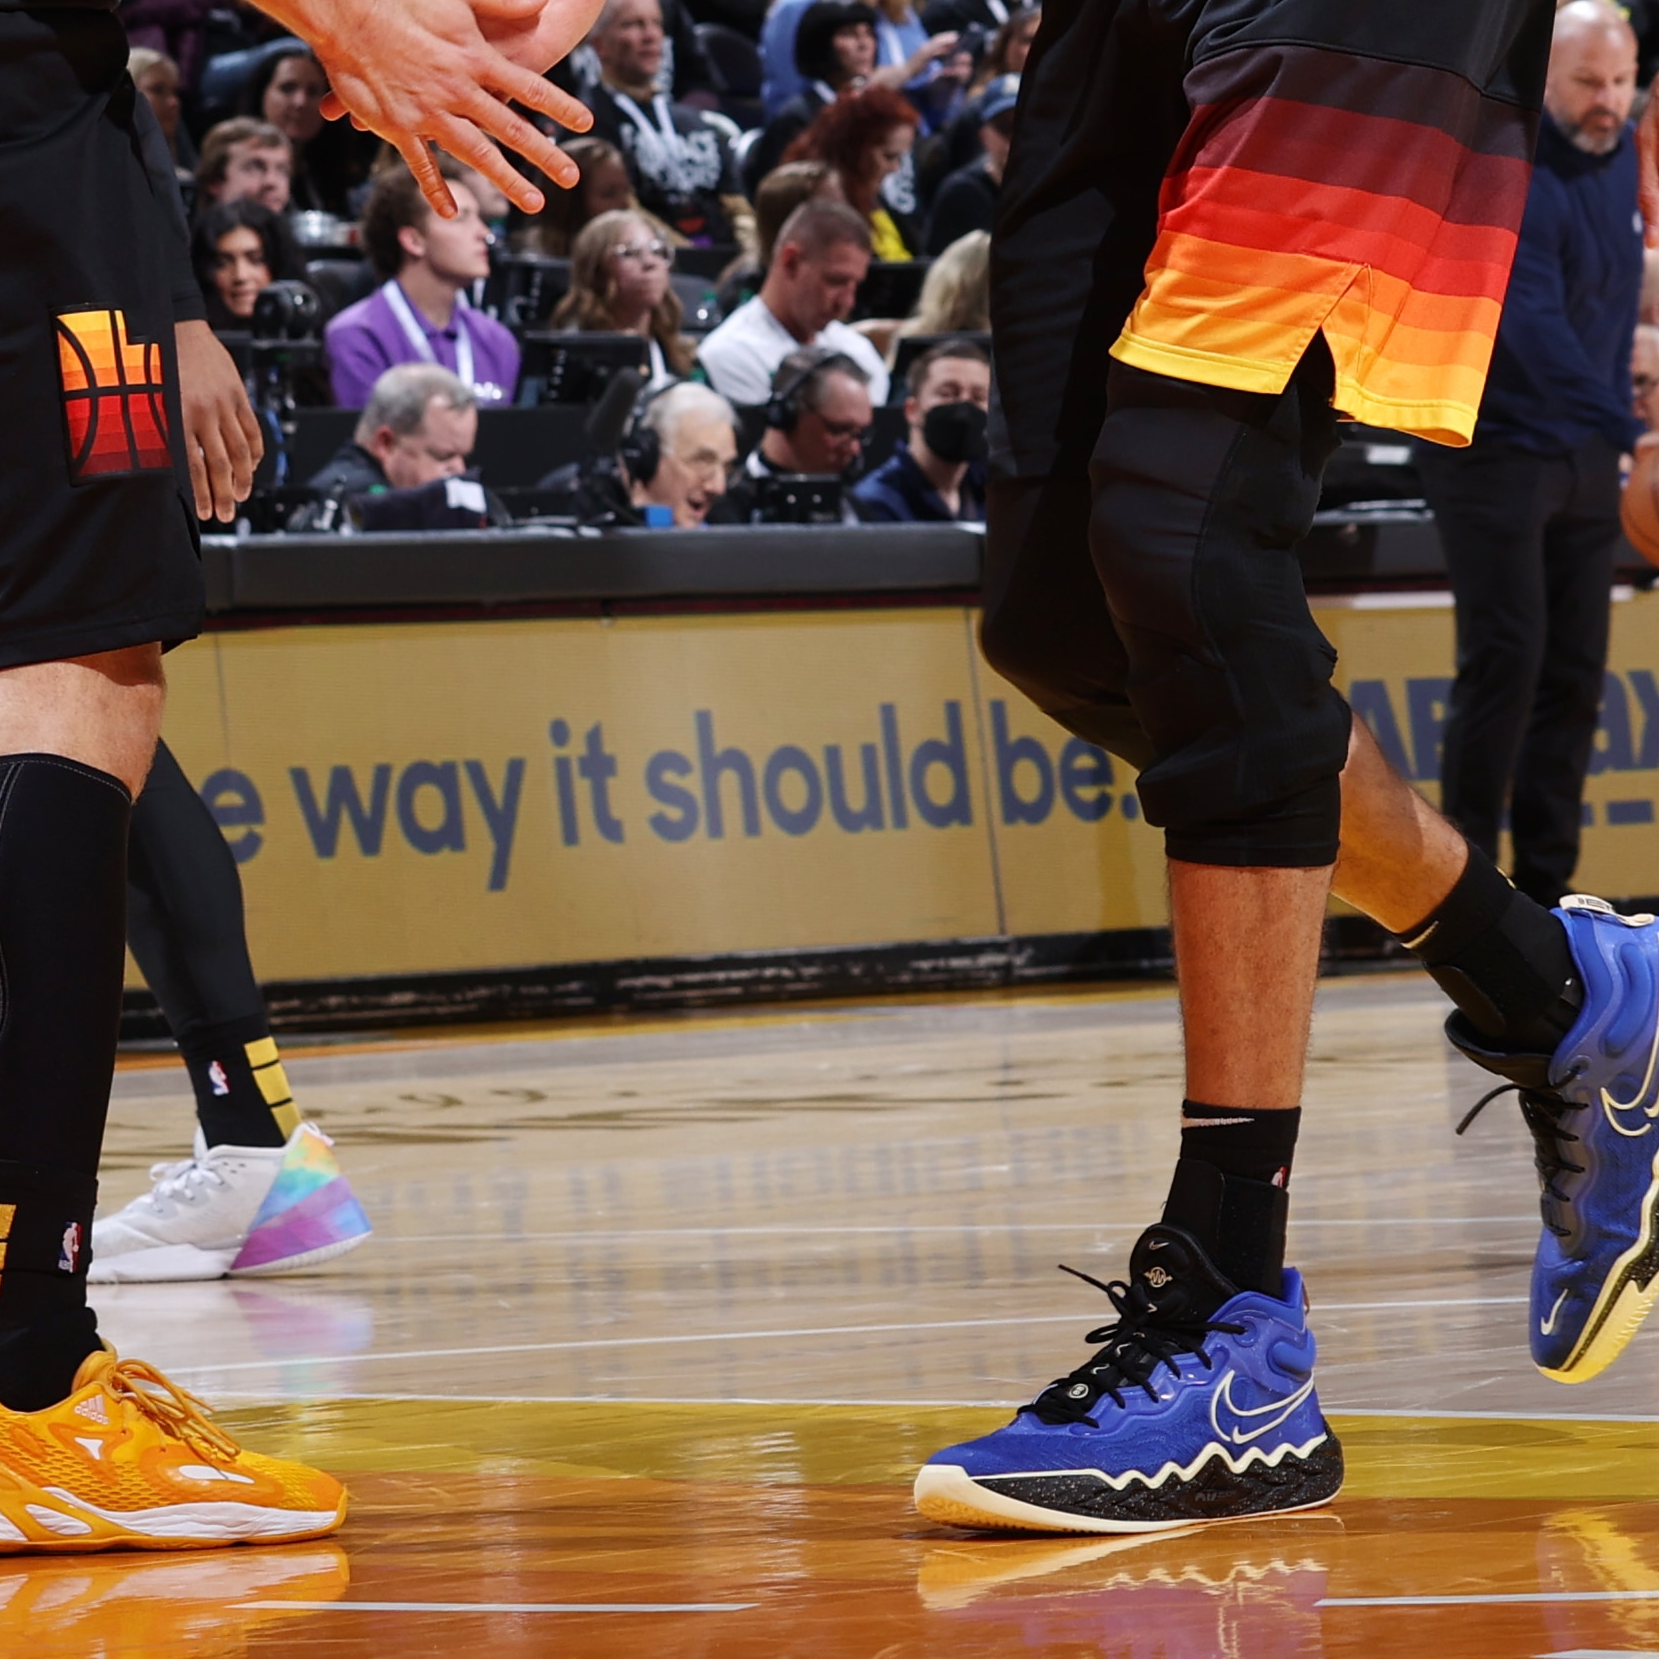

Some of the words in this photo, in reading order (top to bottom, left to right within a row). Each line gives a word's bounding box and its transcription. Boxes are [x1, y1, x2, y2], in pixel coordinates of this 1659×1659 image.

[288, 757, 527, 893] way
[548, 717, 625, 847] it
[644, 702, 973, 843] should
[73, 1404, 111, 1426] adidas
